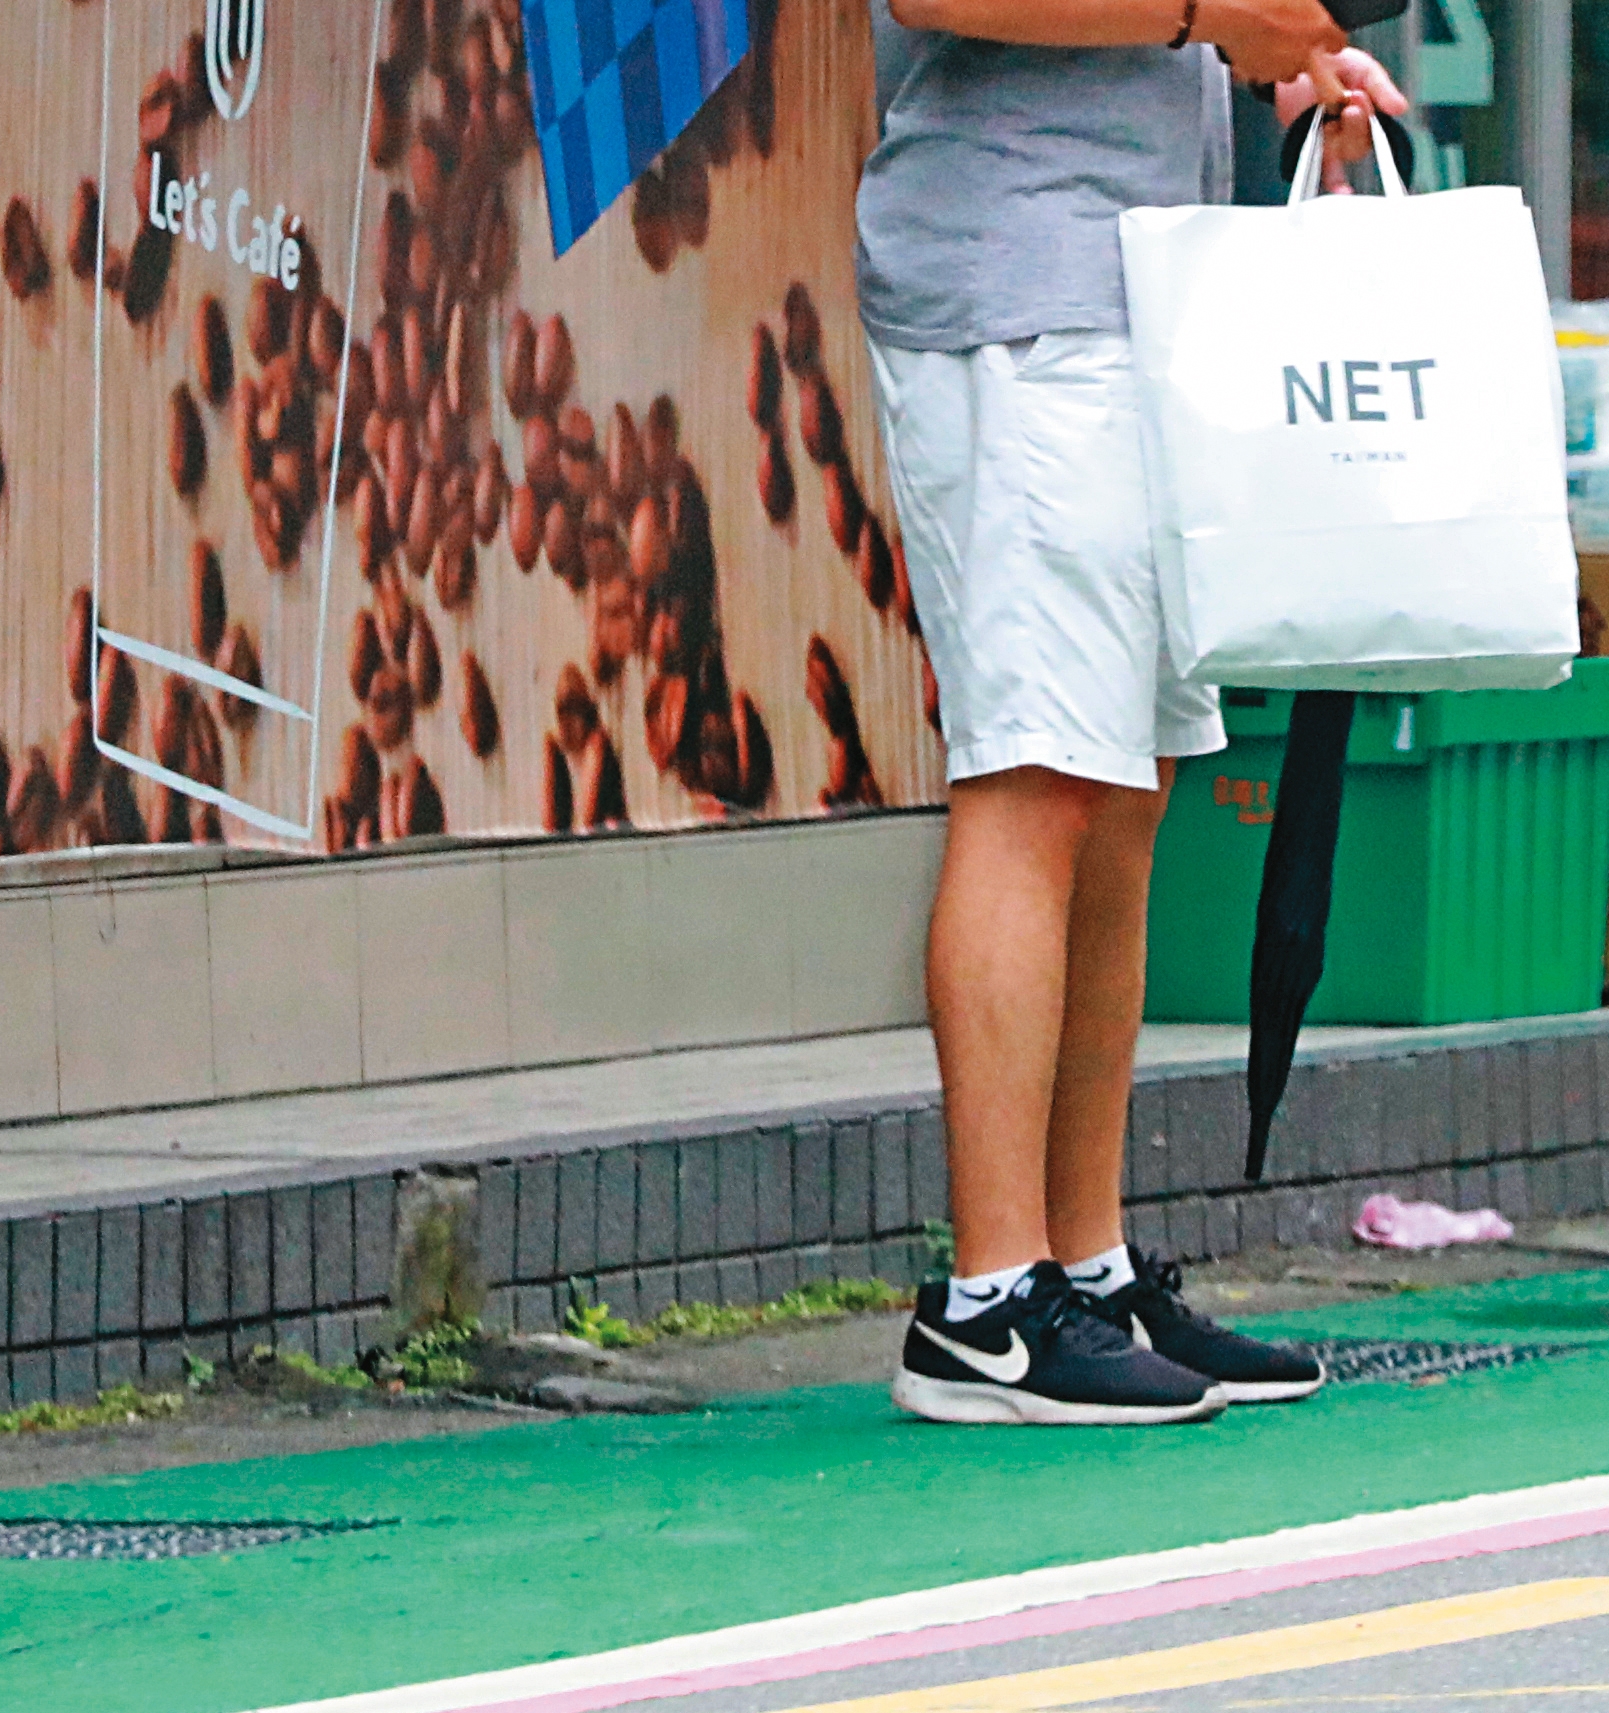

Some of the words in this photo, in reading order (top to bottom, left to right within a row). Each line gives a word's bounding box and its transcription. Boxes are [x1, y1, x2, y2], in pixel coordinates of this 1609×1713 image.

[149, 151, 219, 253] Let's
[226, 187, 303, 292] Café
[1282, 358, 1439, 427] NET
[1329, 450, 1407, 464] TAIWAN
